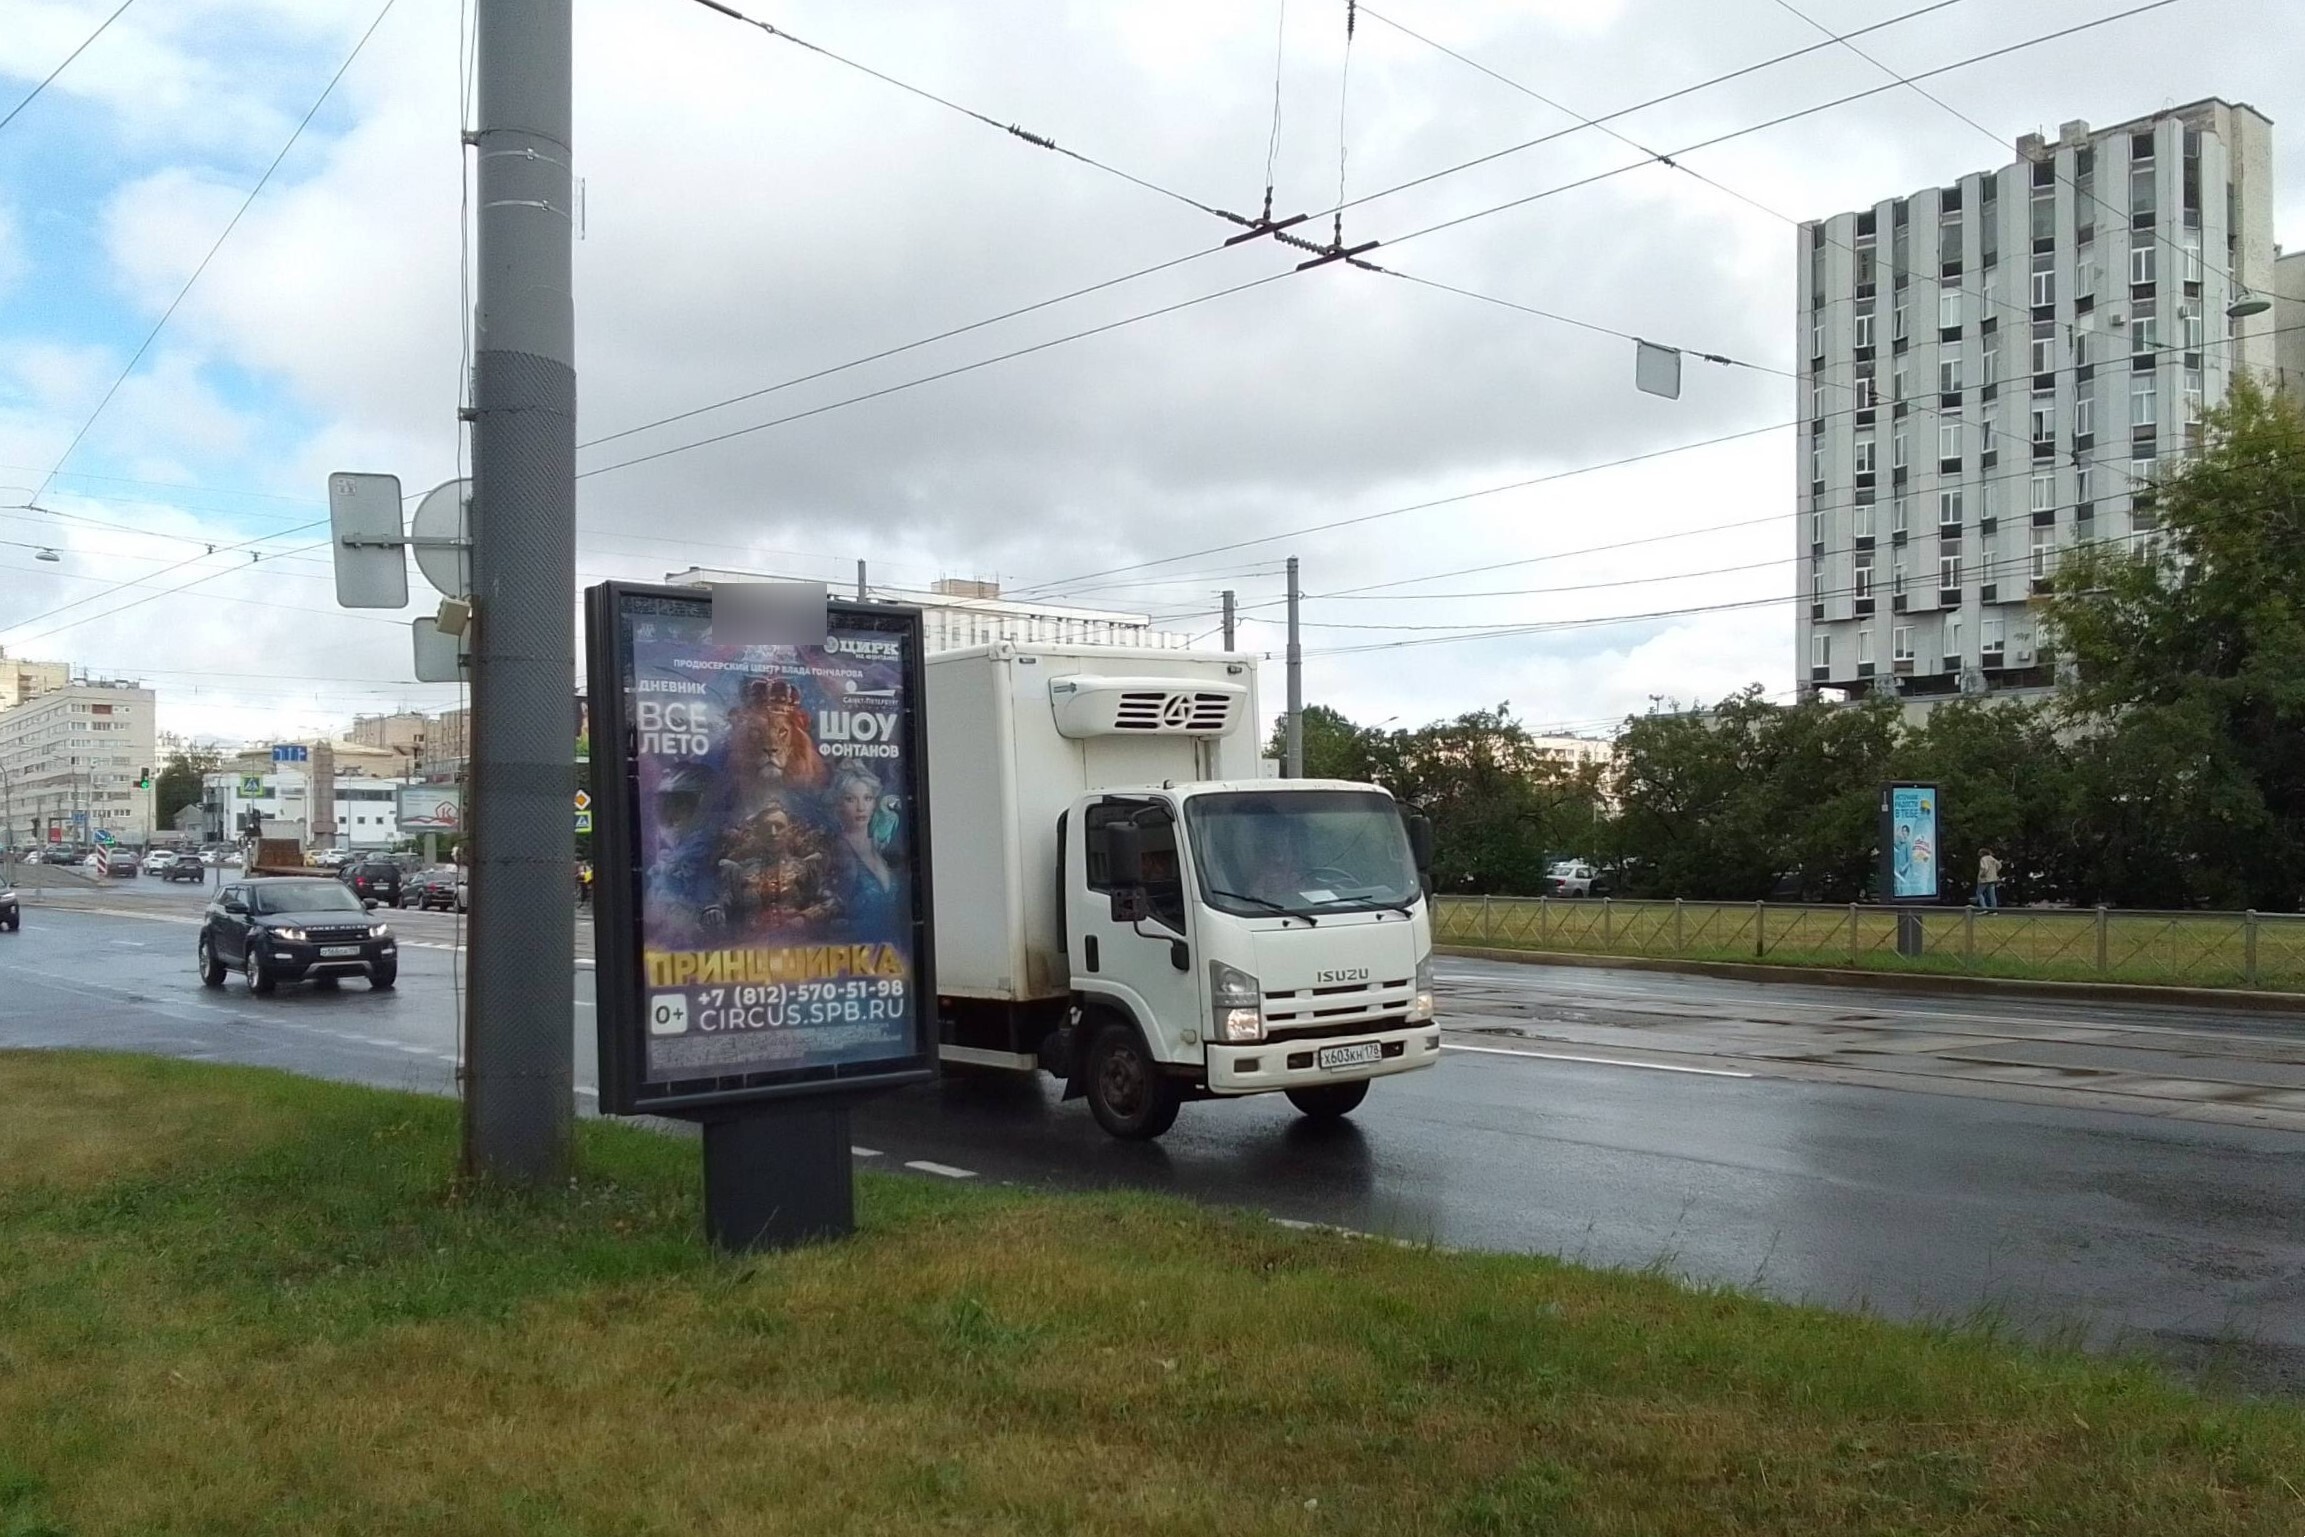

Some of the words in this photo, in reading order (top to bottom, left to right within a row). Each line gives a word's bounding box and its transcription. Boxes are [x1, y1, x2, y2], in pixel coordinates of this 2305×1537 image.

[839, 640, 899, 655] ЦИРК
[673, 659, 749, 672] ПРОДЮСЕРСКИЙ
[750, 662, 780, 674] ЦЕНТР
[781, 665, 811, 676] ВЛАДА
[811, 667, 864, 678] ГОНЧАРОВА
[639, 679, 706, 695] ДНЕВНИК
[638, 701, 709, 733] ВСЕ
[820, 710, 898, 742] ШОУ
[640, 732, 709, 756] ЛЕТО
[819, 743, 899, 758] ФОНТАНОВ
[648, 949, 771, 987] ПРИНЦ
[781, 943, 904, 980] ЦИРКА
[1317, 968, 1369, 983] ISUZU
[698, 988, 726, 1007] +7
[734, 980, 904, 1008] (812)-570-51-98
[655, 1004, 685, 1025] 0+
[700, 998, 904, 1031] CIRCUS.SPB.RU
